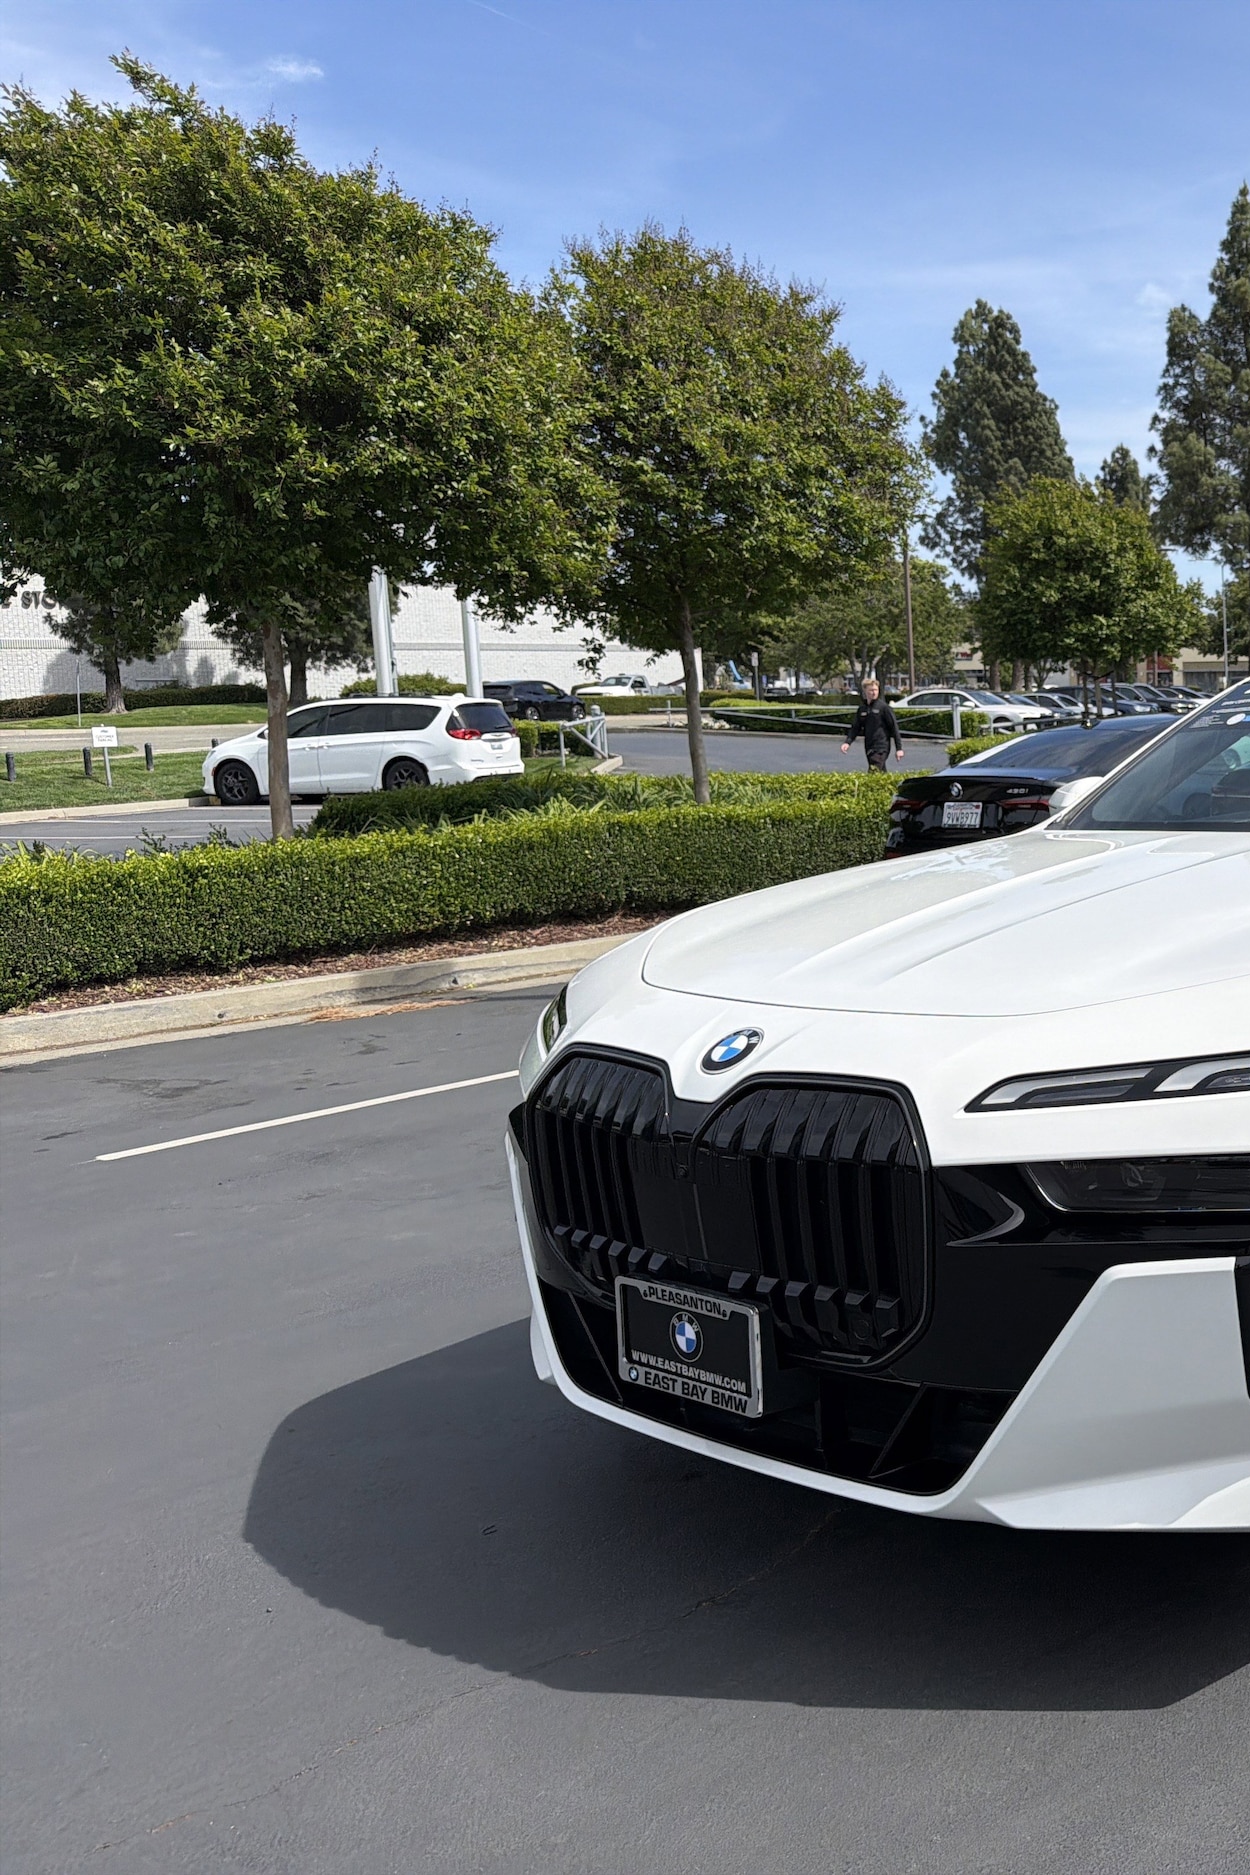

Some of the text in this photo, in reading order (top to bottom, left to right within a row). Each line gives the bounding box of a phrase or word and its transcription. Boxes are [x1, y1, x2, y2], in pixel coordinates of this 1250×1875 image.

[647, 1285, 722, 1316] PLEASANTON
[672, 1313, 700, 1333] BMW
[631, 1350, 746, 1393] WWW.EASTBAYBMW.COM
[644, 1370, 749, 1414] EAST BAY BMW
